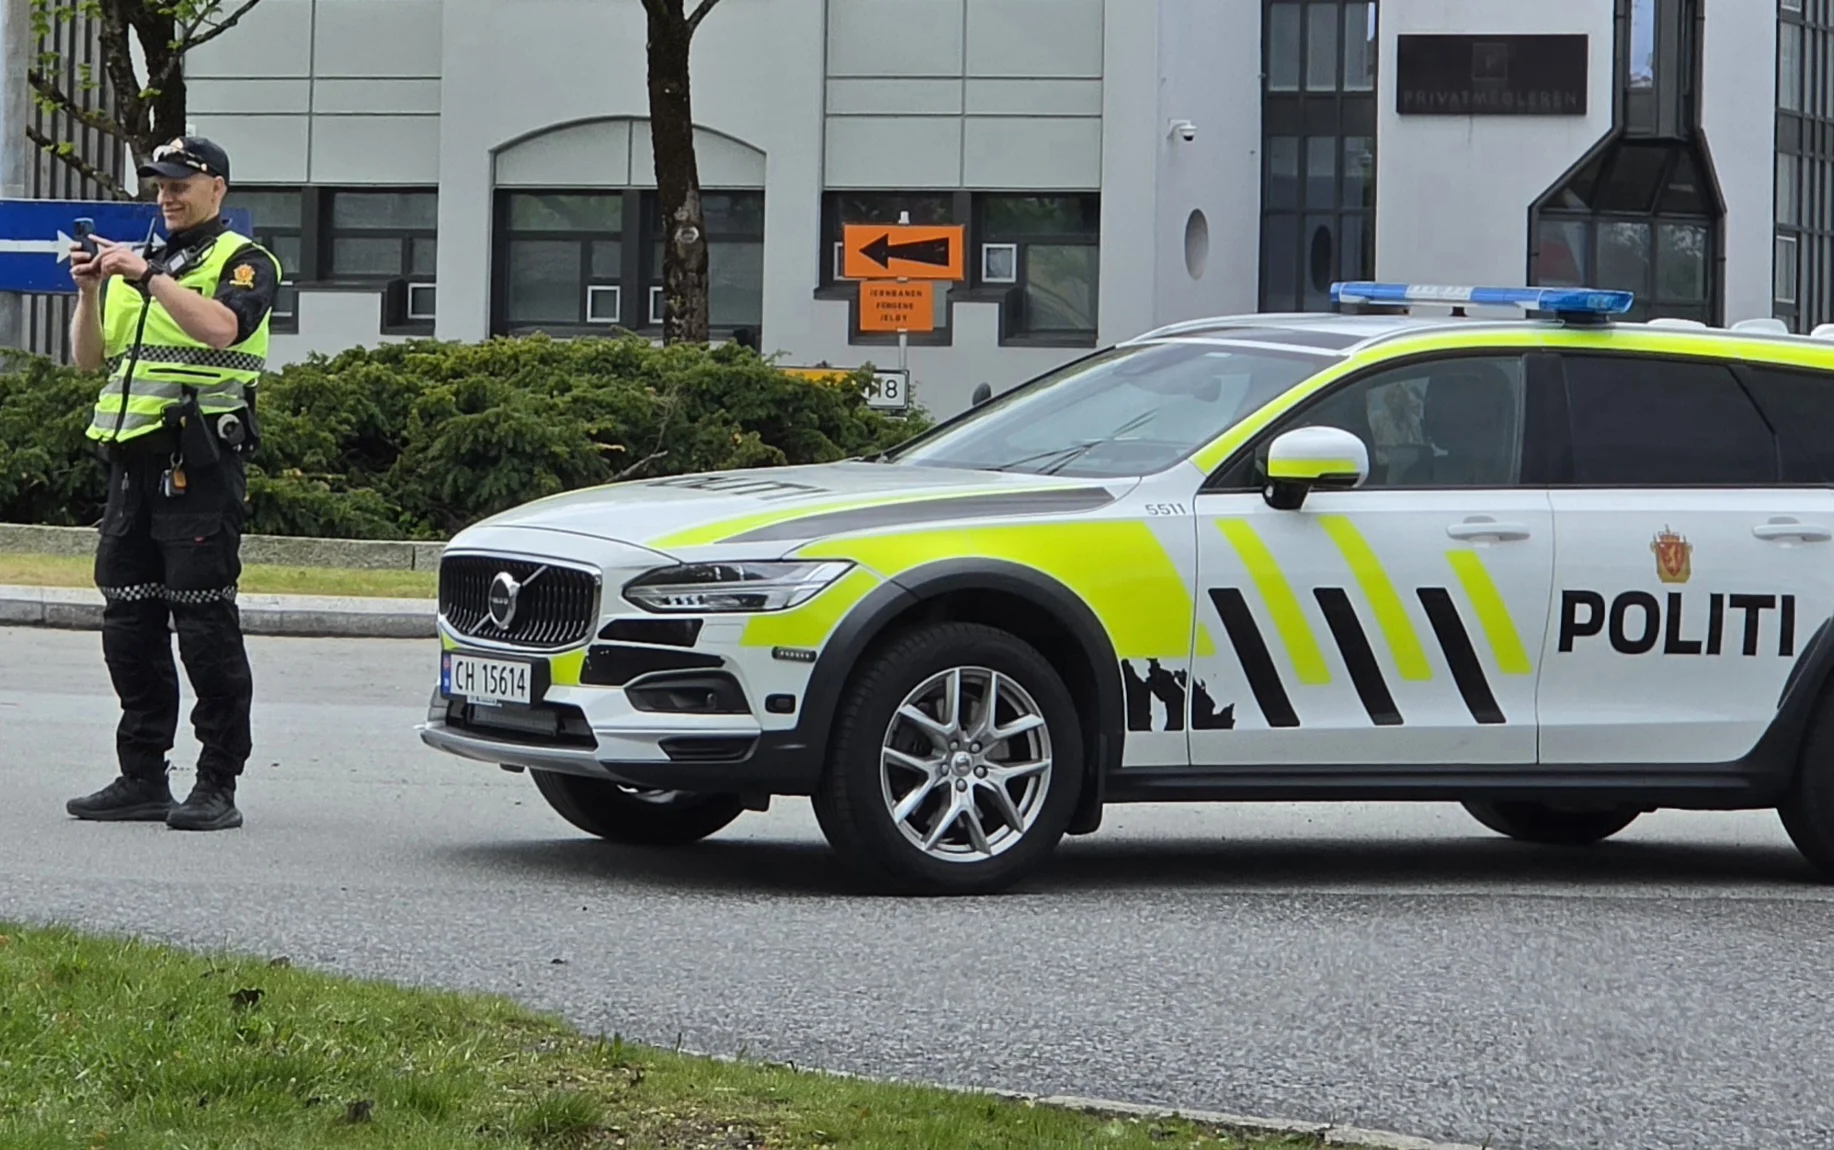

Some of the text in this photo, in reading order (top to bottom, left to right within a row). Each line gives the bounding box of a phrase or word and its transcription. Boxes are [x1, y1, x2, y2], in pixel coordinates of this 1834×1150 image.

[1144, 503, 1187, 516] 5511
[1558, 589, 1796, 657] POLITI
[456, 660, 526, 697] CH 15614
